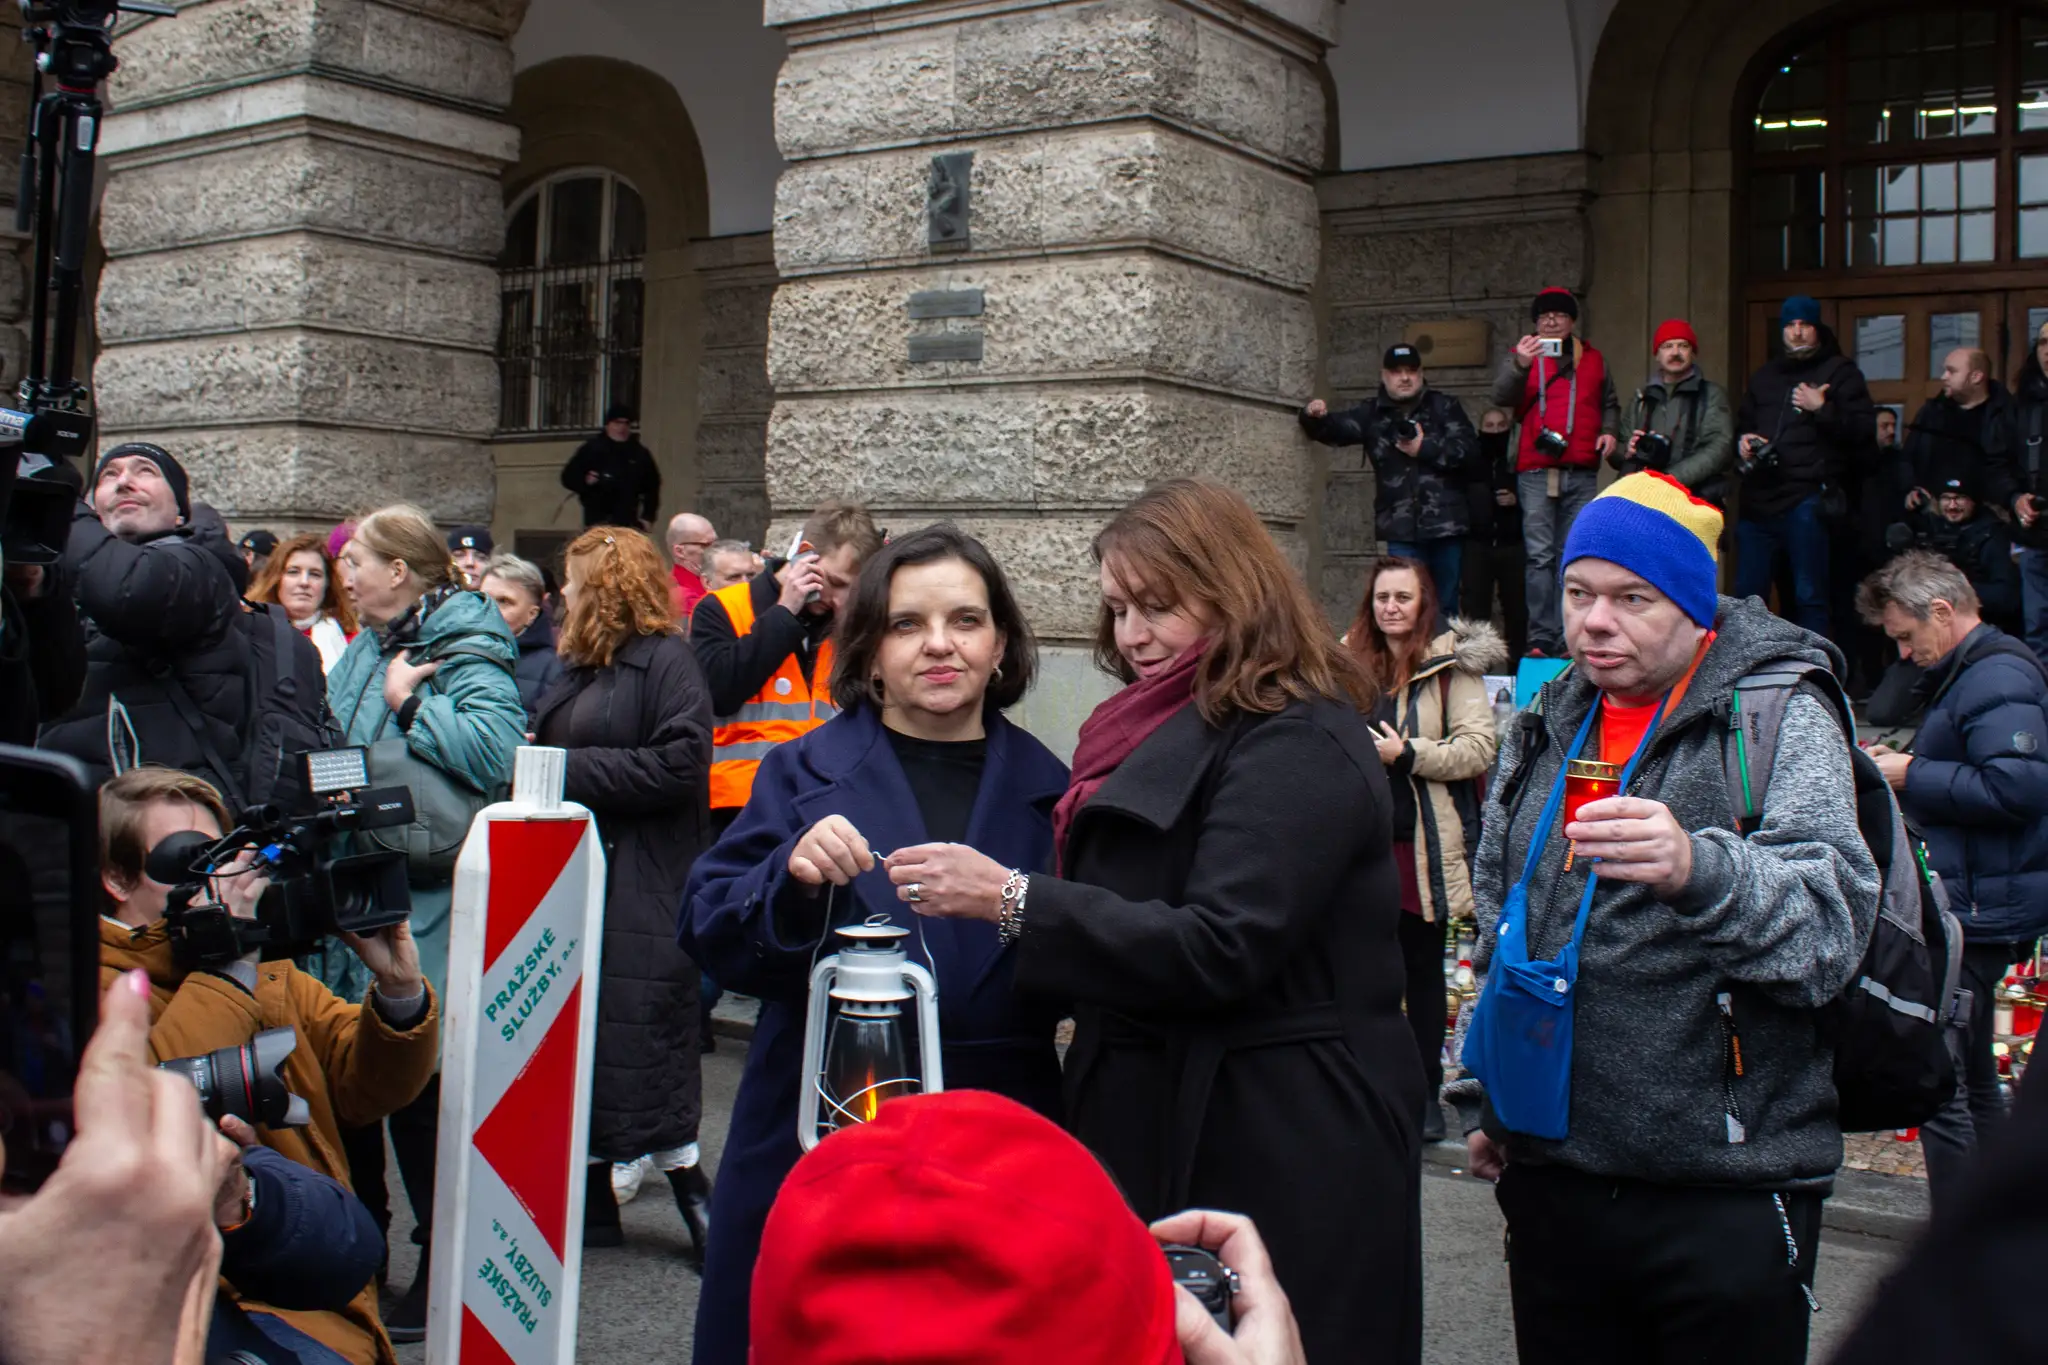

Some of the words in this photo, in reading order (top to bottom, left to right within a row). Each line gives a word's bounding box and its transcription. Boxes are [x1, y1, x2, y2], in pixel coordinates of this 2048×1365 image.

[485, 927, 556, 1022] PRAŽSKÉ
[501, 960, 562, 1042] SLUŽBY,
[478, 1257, 538, 1335] PRAŽSKÉ
[505, 1238, 552, 1307] SLUŽBY,
